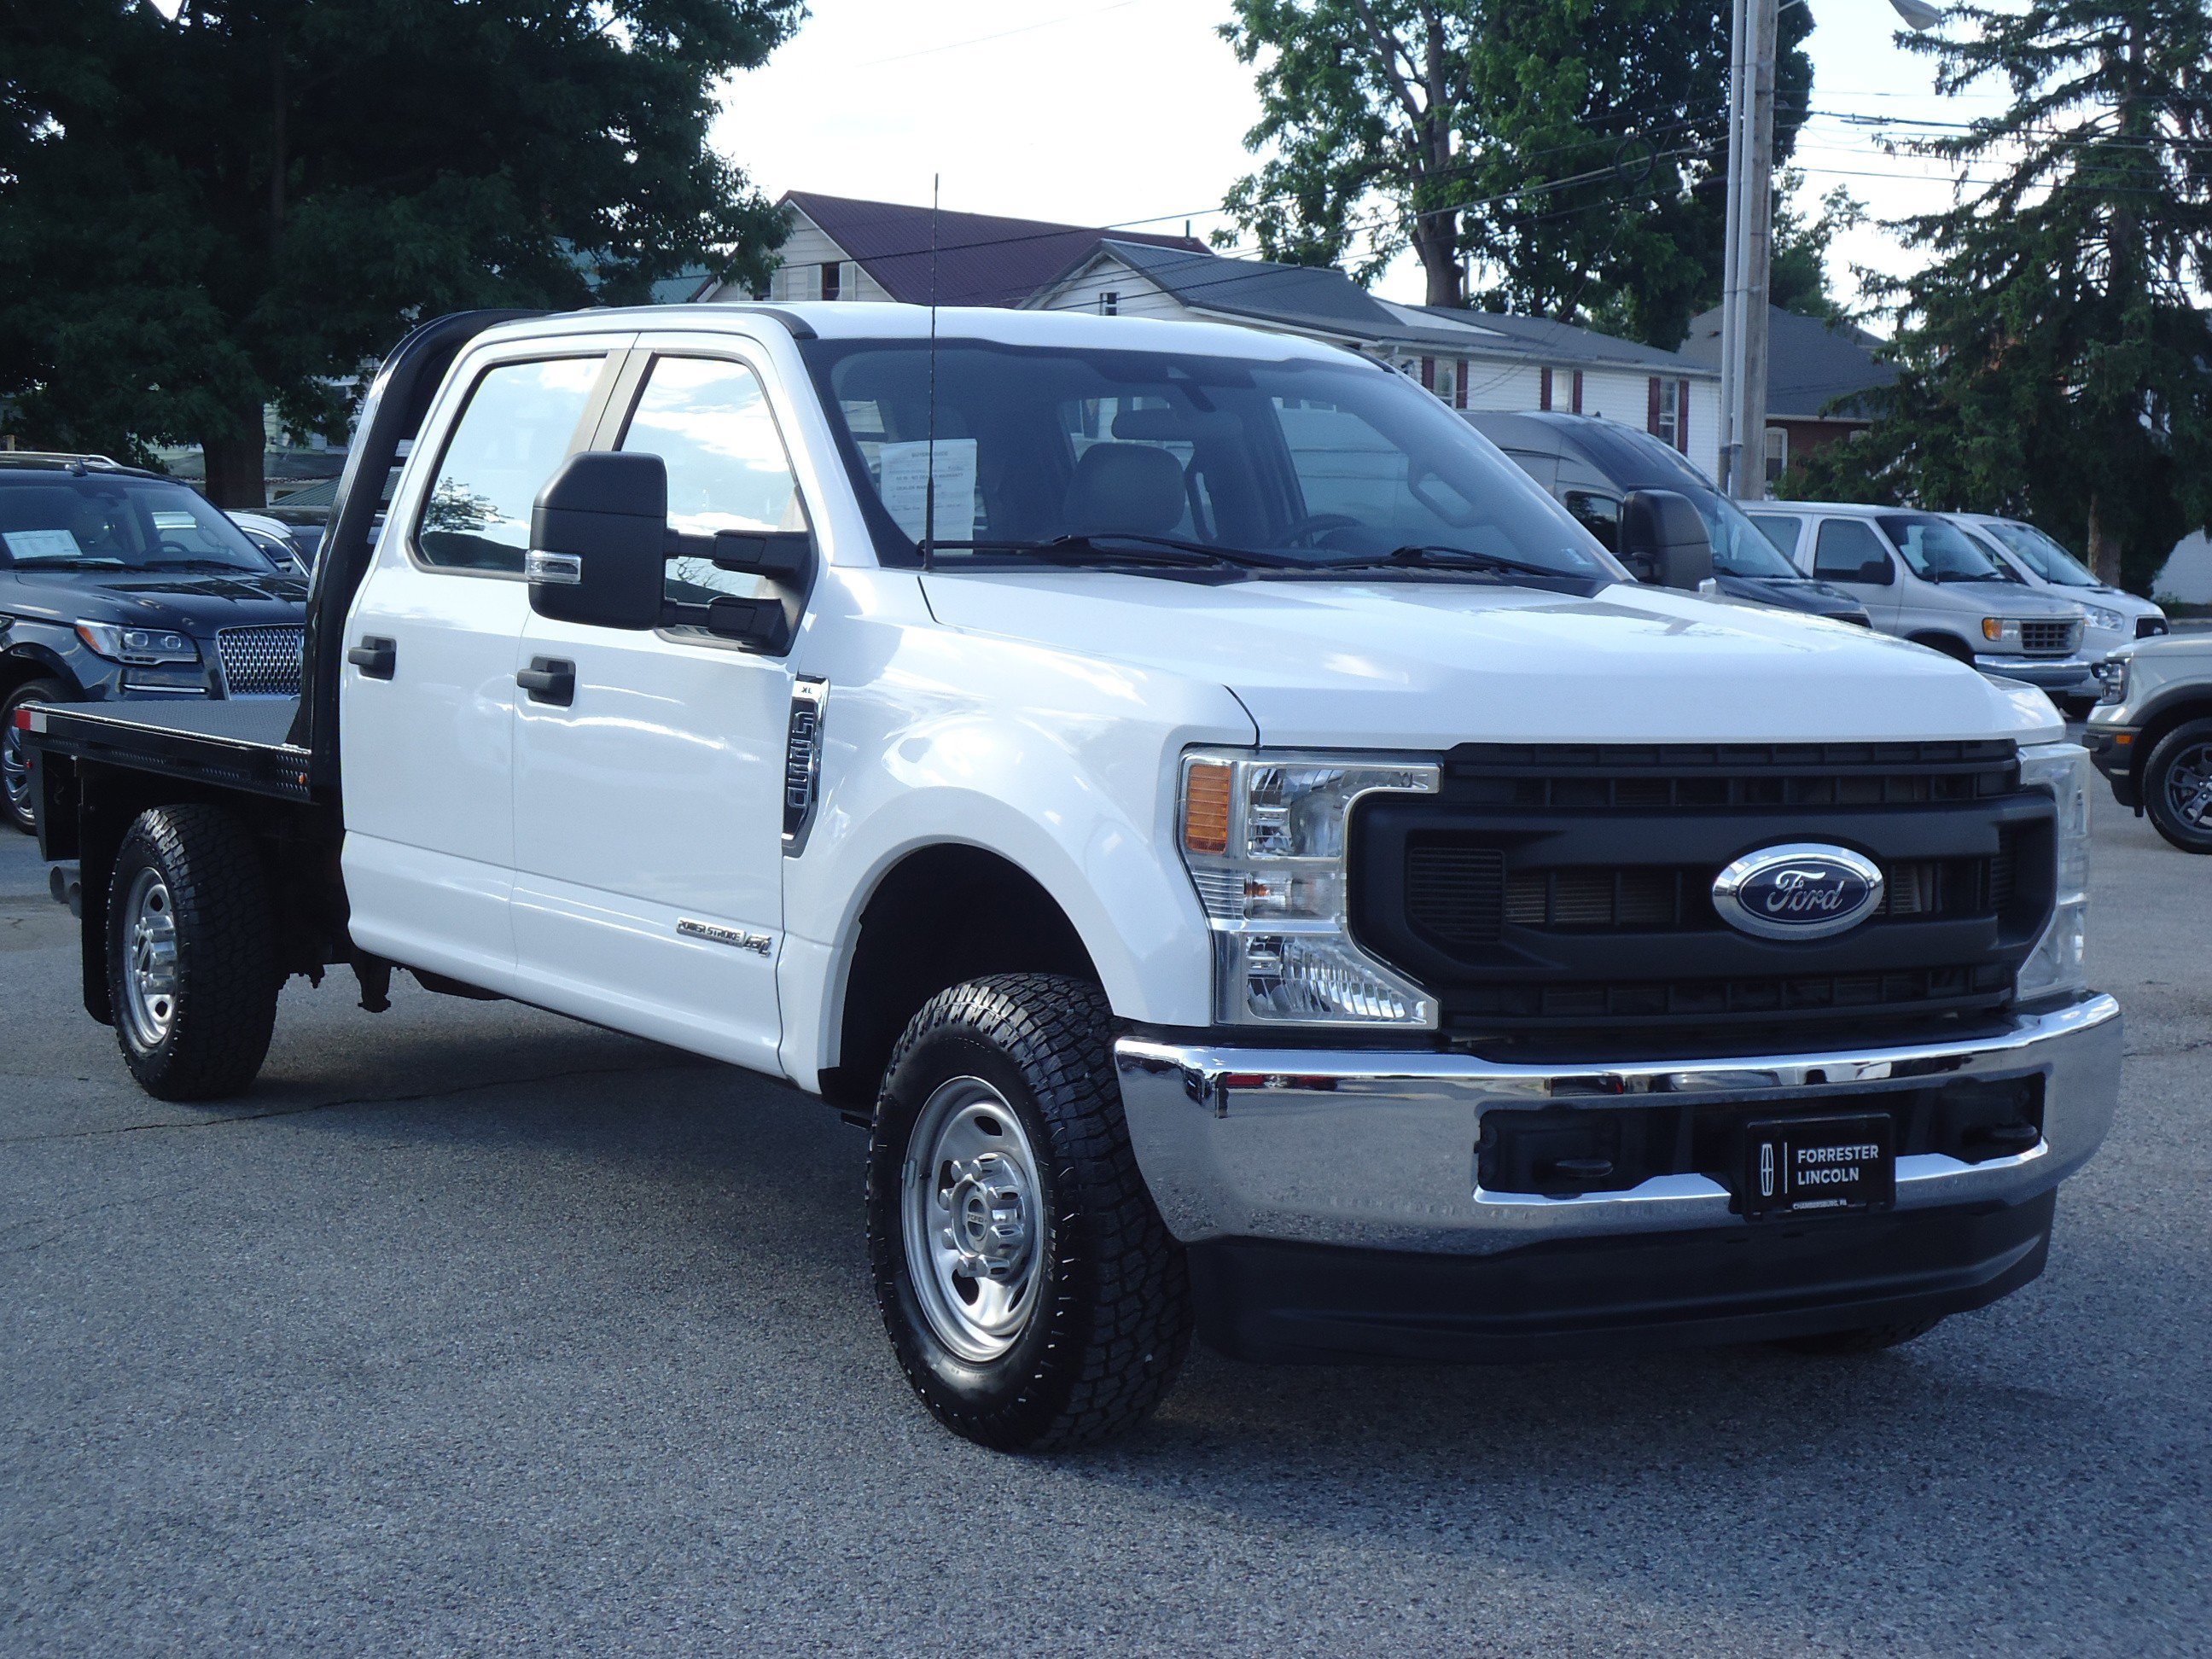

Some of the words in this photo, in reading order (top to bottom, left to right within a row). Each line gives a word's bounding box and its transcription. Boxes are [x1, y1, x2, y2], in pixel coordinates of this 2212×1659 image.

[1767, 870, 1845, 912] Ford
[1797, 1144, 1879, 1164] FORRESTER
[1798, 1167, 1859, 1185] LINCOLN
